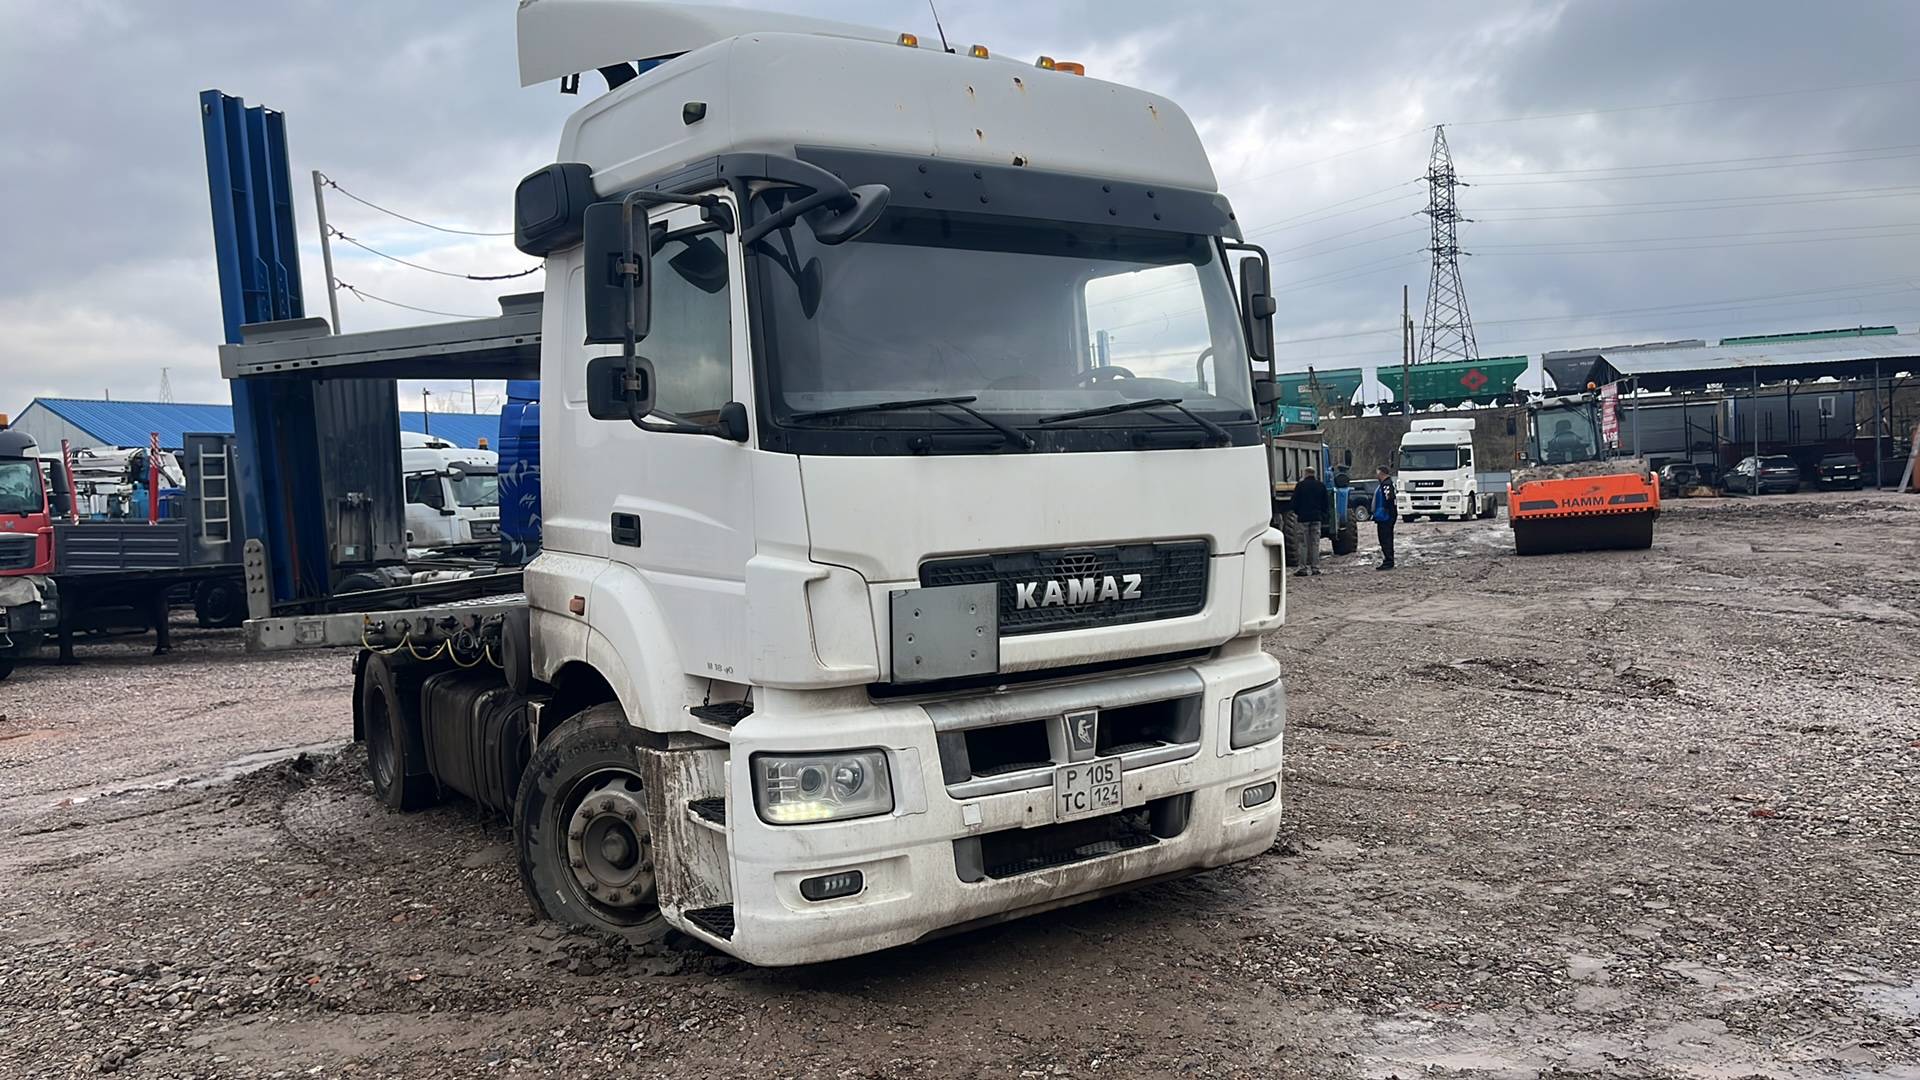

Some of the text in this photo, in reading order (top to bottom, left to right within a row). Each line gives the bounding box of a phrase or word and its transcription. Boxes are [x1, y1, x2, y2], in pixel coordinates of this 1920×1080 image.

[1561, 496, 1604, 508] HAMM
[1016, 574, 1141, 609] KAMAZ
[1086, 763, 1114, 785] 105
[1094, 784, 1118, 802] 124
